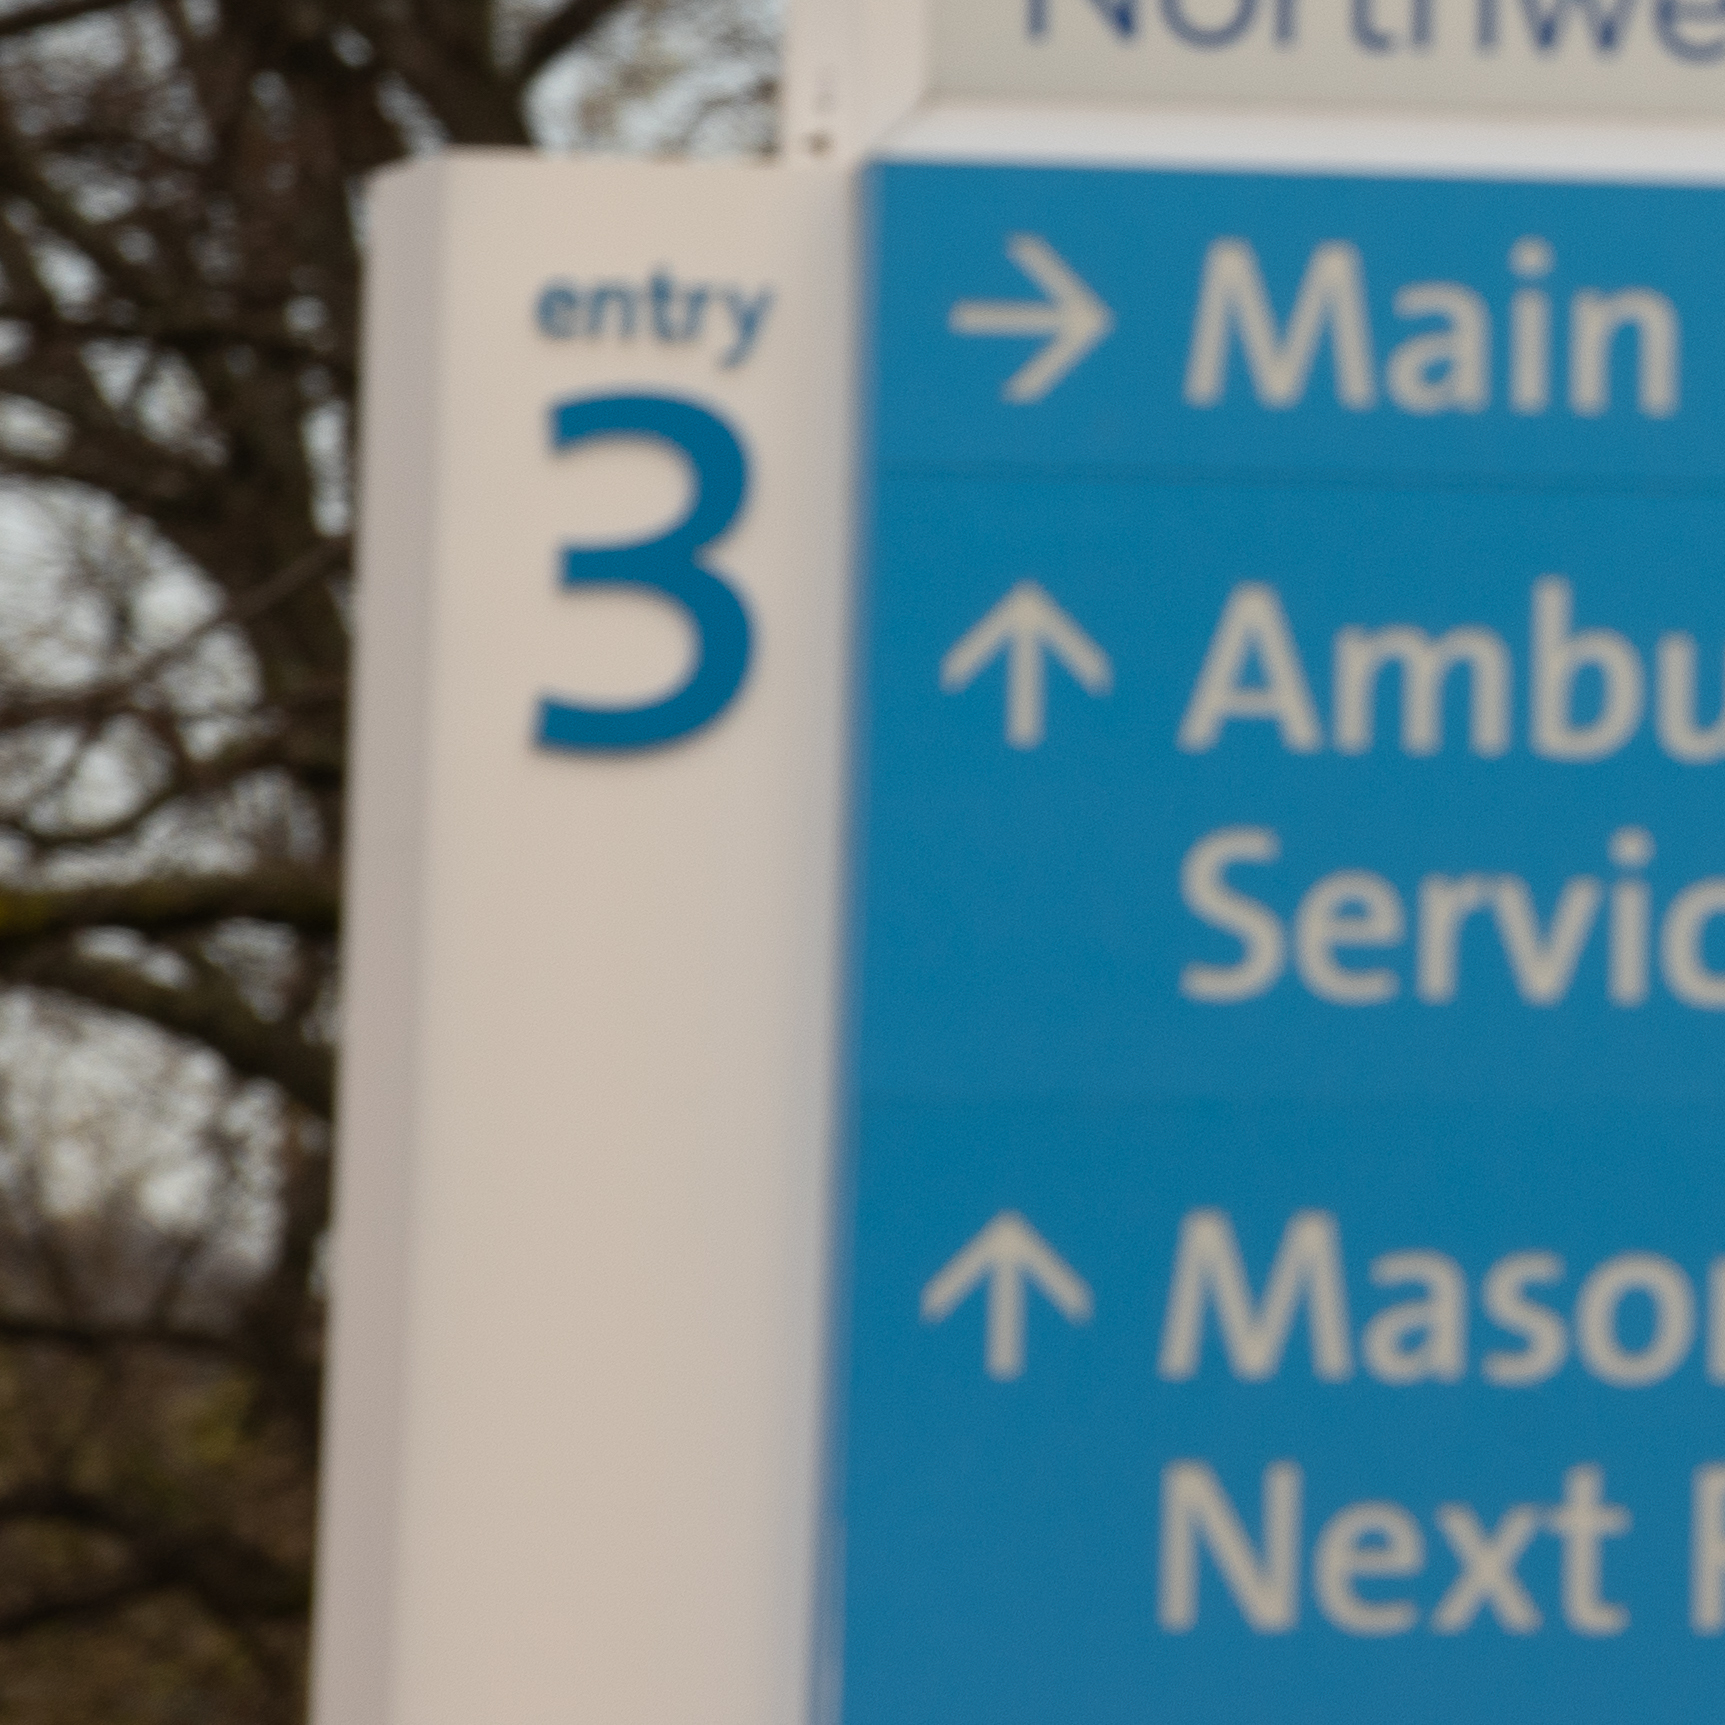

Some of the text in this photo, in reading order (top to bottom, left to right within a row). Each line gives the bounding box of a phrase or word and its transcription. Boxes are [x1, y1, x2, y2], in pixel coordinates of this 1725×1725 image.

[533, 269, 773, 371] entry
[1183, 236, 1681, 419] Main
[534, 390, 758, 757] 3
[1156, 1457, 1631, 1638] Next
